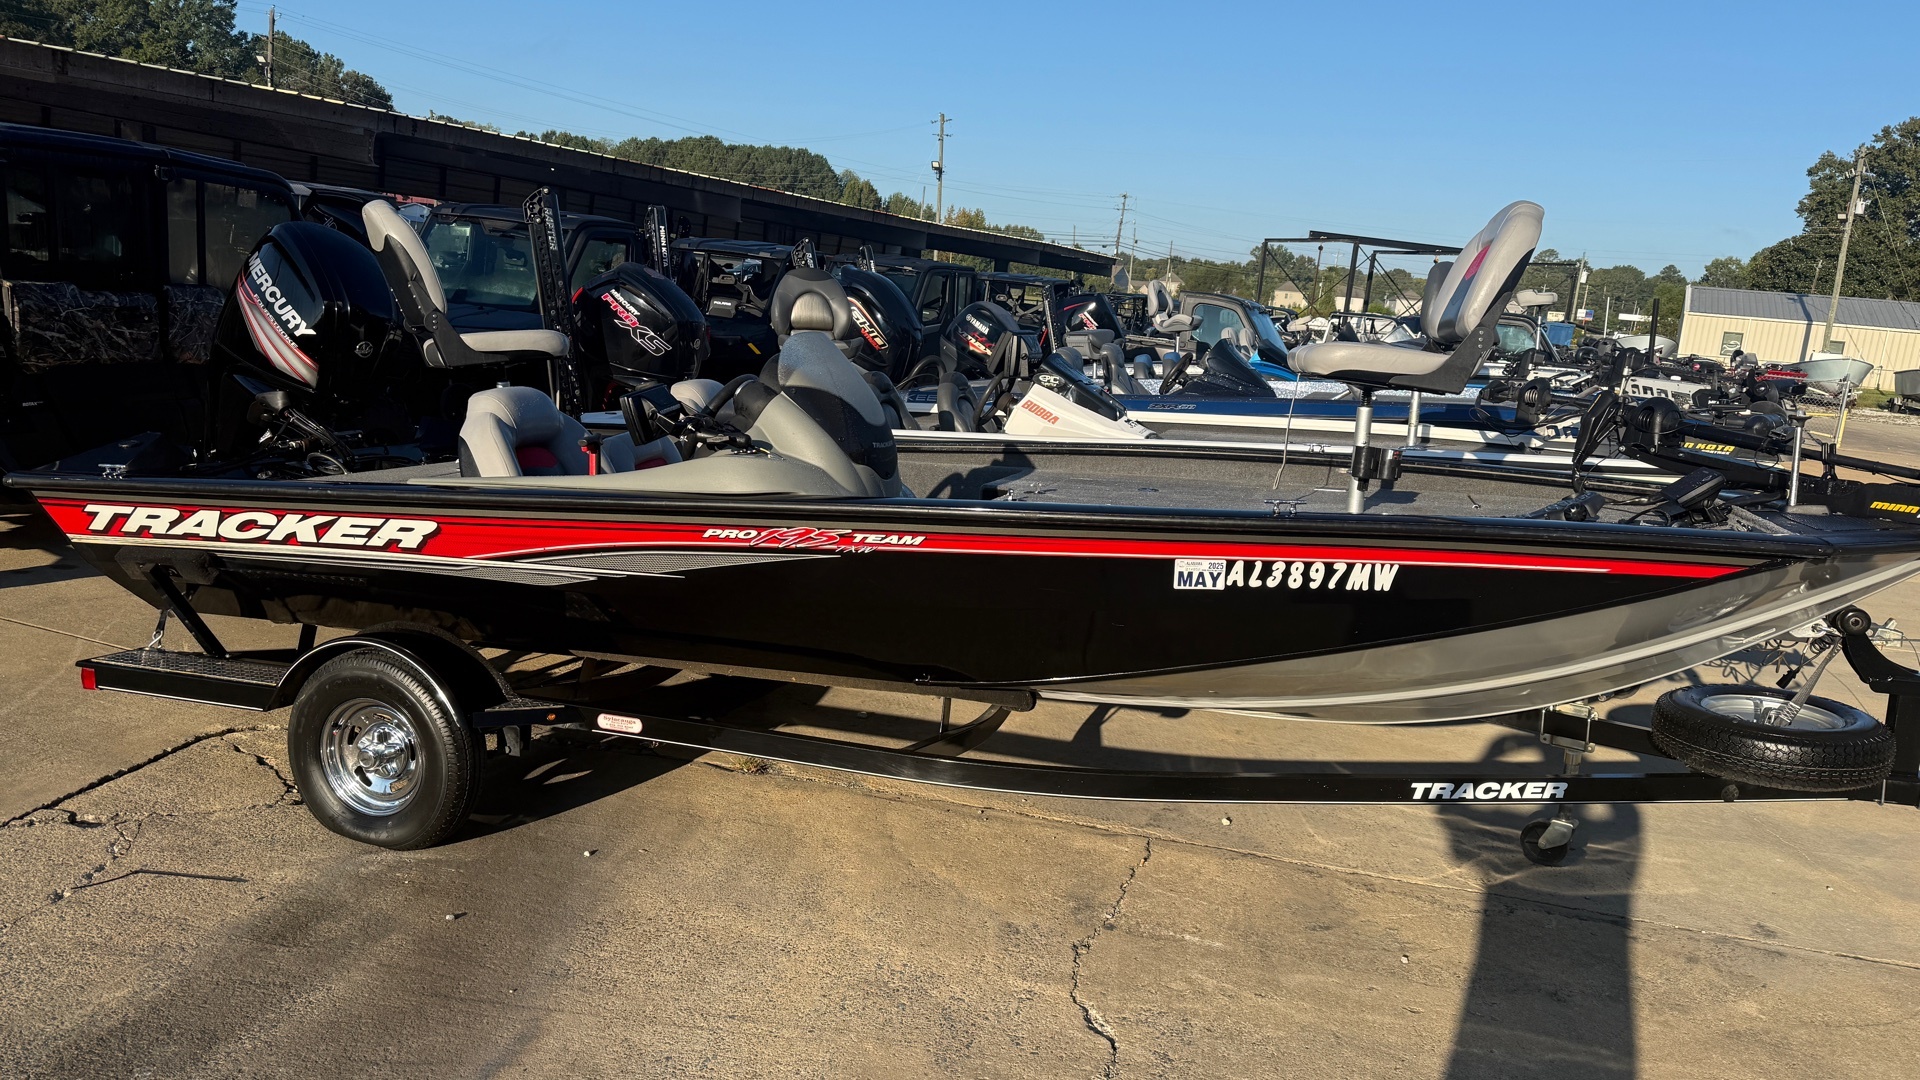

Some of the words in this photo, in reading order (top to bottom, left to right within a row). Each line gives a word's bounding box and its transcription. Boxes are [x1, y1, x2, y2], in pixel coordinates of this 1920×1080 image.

[659, 225, 667, 246] MINN
[248, 251, 317, 337] MERCURY
[609, 288, 640, 316] MERCURY
[253, 293, 299, 349] FOURSTROKE
[969, 315, 990, 335] YAMAHA
[613, 318, 672, 357] XS
[1021, 399, 1060, 425] BOBBA
[1695, 442, 1736, 452] KOTA
[84, 504, 438, 549] TRACKER
[702, 529, 758, 540] PRO
[750, 526, 852, 548] 195
[852, 533, 927, 546] TEAM
[1208, 562, 1224, 570] 2025
[1177, 571, 1222, 588] MAY
[1411, 781, 1568, 800] TRACKER
